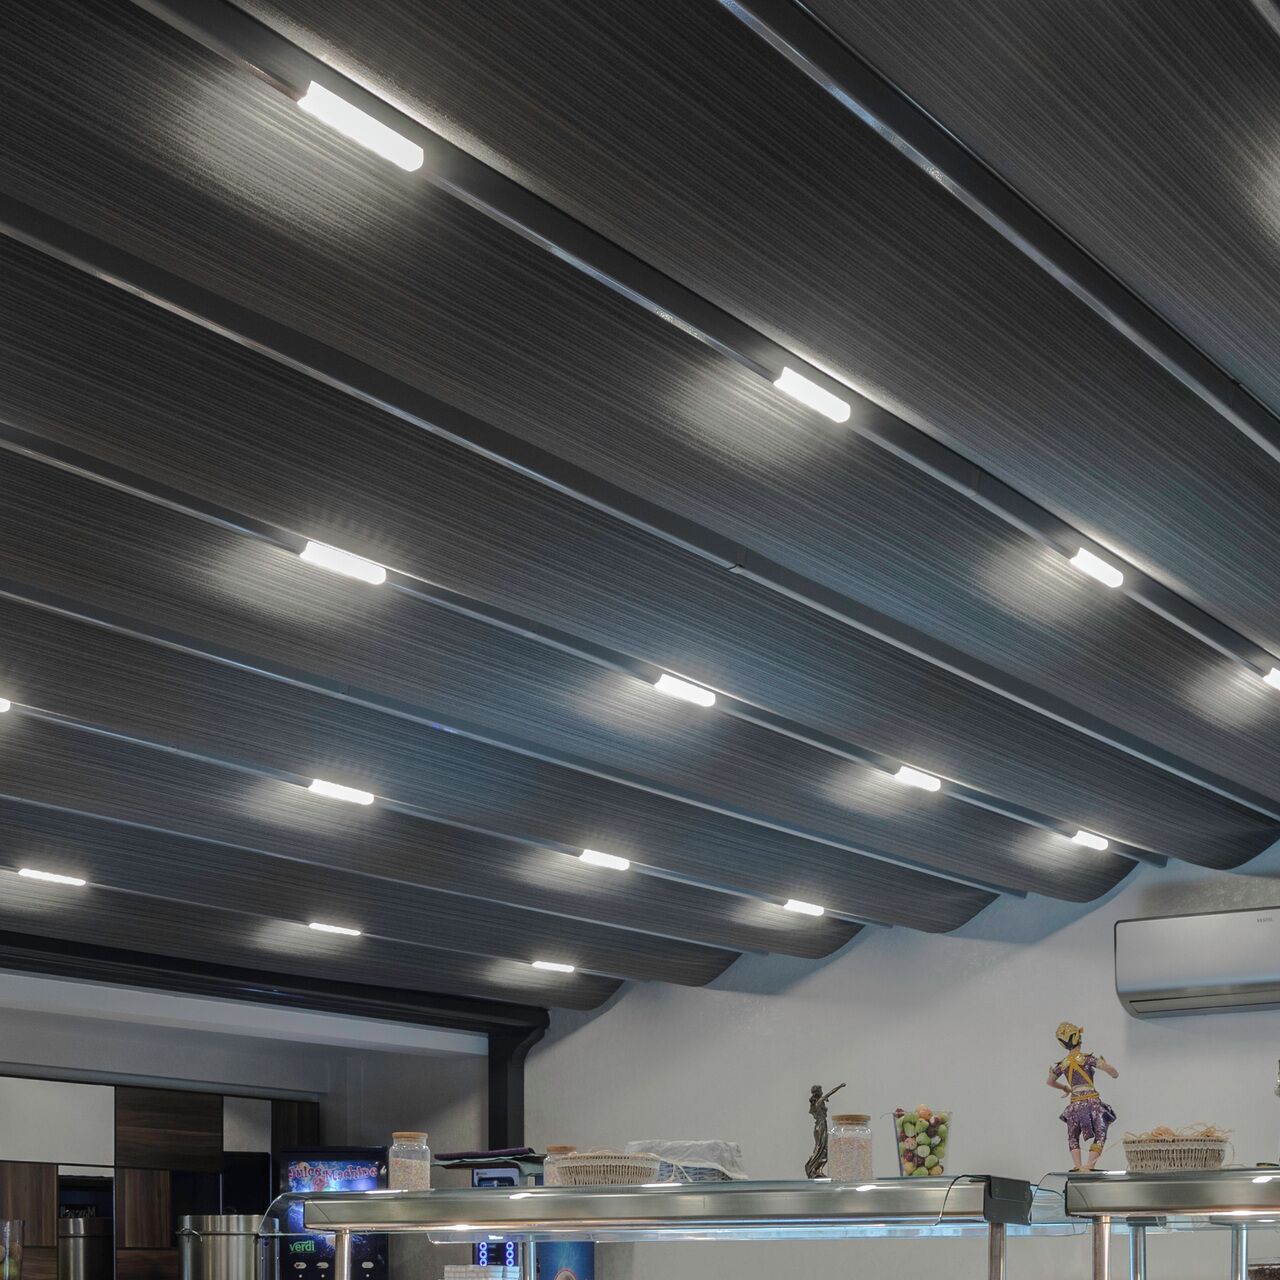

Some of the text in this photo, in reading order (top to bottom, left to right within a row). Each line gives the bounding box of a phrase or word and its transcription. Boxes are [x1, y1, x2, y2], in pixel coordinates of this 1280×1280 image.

[288, 1165, 378, 1180] Juice Machine
[289, 1241, 315, 1251] verdi
